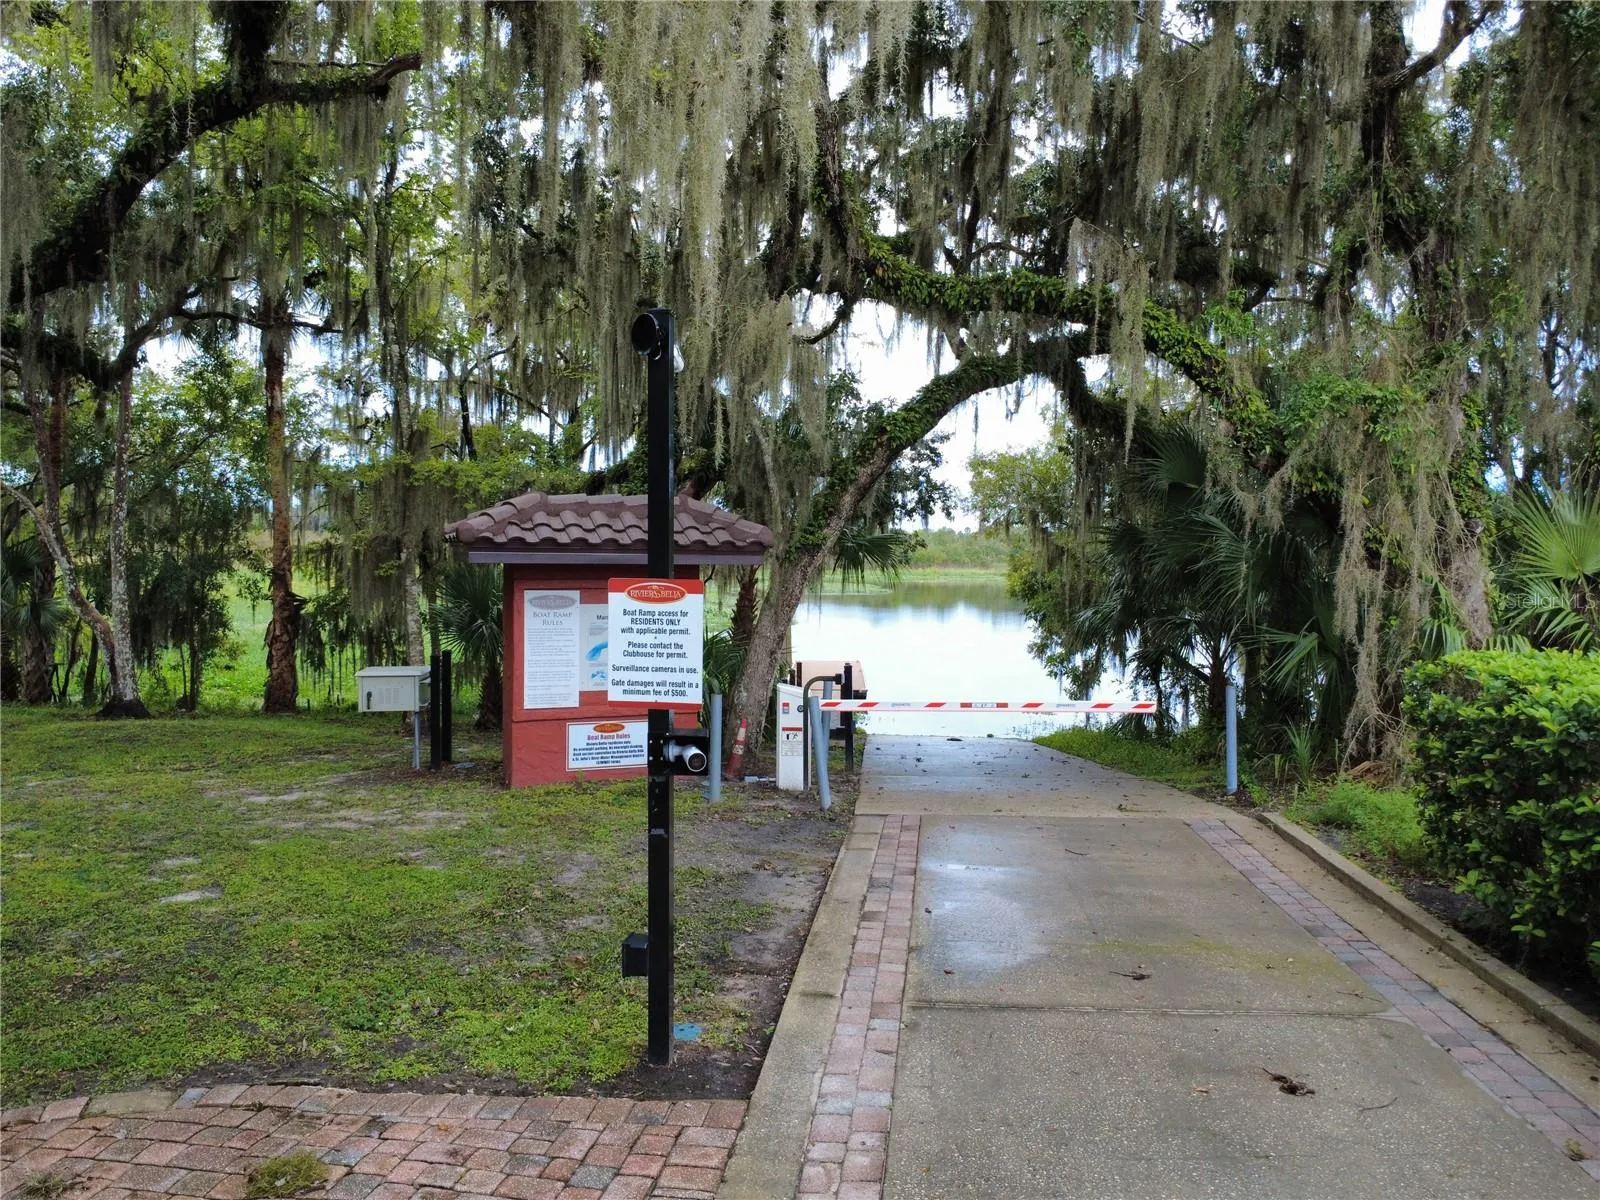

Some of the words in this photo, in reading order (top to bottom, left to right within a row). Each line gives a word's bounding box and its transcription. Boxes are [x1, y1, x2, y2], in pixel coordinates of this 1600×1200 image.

[638, 609, 656, 618] Ramp
[612, 664, 649, 672] Surveillance
[626, 680, 654, 688] damages
